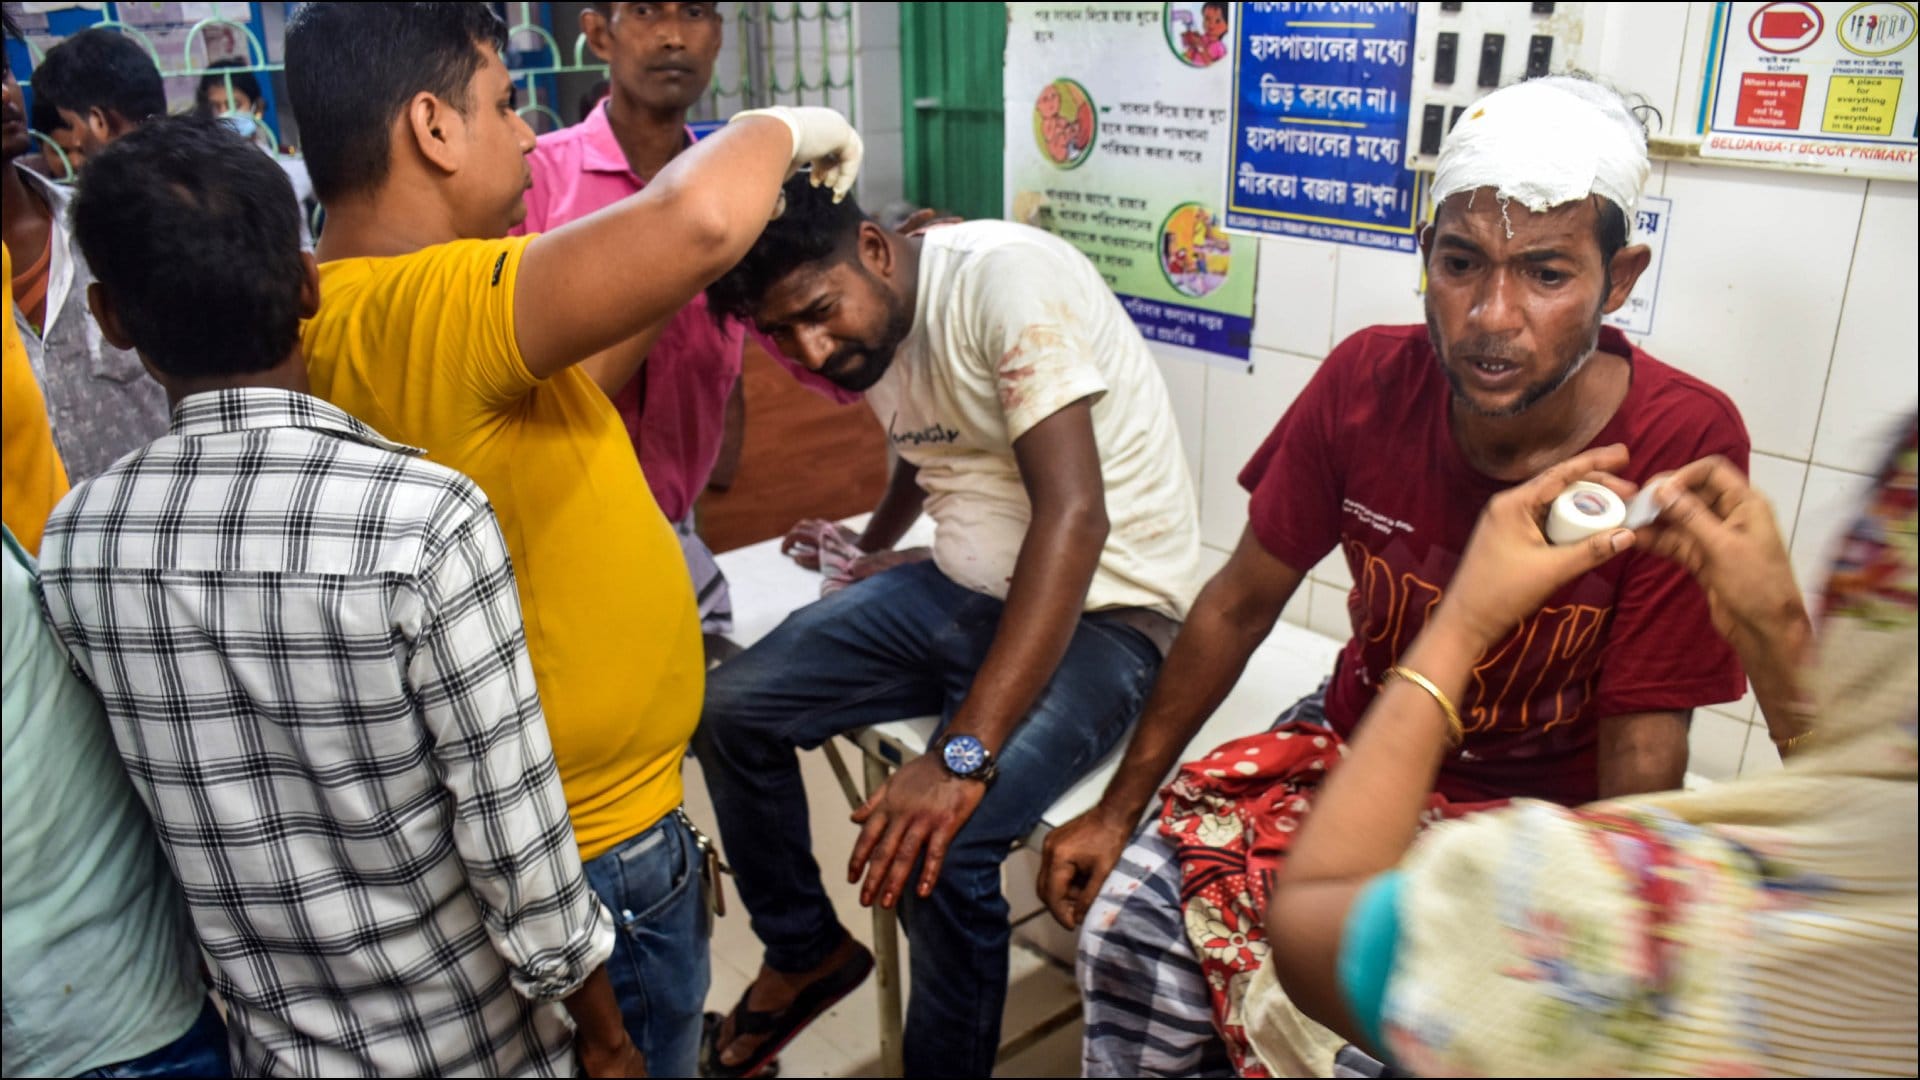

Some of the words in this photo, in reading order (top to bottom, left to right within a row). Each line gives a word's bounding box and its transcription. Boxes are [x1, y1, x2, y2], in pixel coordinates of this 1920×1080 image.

[1249, 34, 1357, 63] হাসপাতালের
[1363, 38, 1408, 67] মধ্যে
[1744, 78, 1766, 87] When
[1768, 79, 1776, 87] in
[1857, 79, 1882, 87] place
[1260, 72, 1294, 112] ভিড়
[1299, 83, 1361, 113] করবেন
[1856, 87, 1870, 95] for
[1837, 97, 1886, 107] everything
[1753, 108, 1767, 116] red
[1768, 109, 1783, 118] Tag
[1851, 105, 1868, 113] and
[1834, 114, 1882, 125] everything
[1832, 122, 1840, 130] in
[1856, 124, 1881, 133] place
[1245, 126, 1351, 158] হাসপাতালের
[1355, 136, 1400, 165] মধ্যে
[1849, 146, 1917, 163] PRIMARY
[1237, 162, 1298, 200] নীরবতা
[1302, 175, 1348, 205] বজায়
